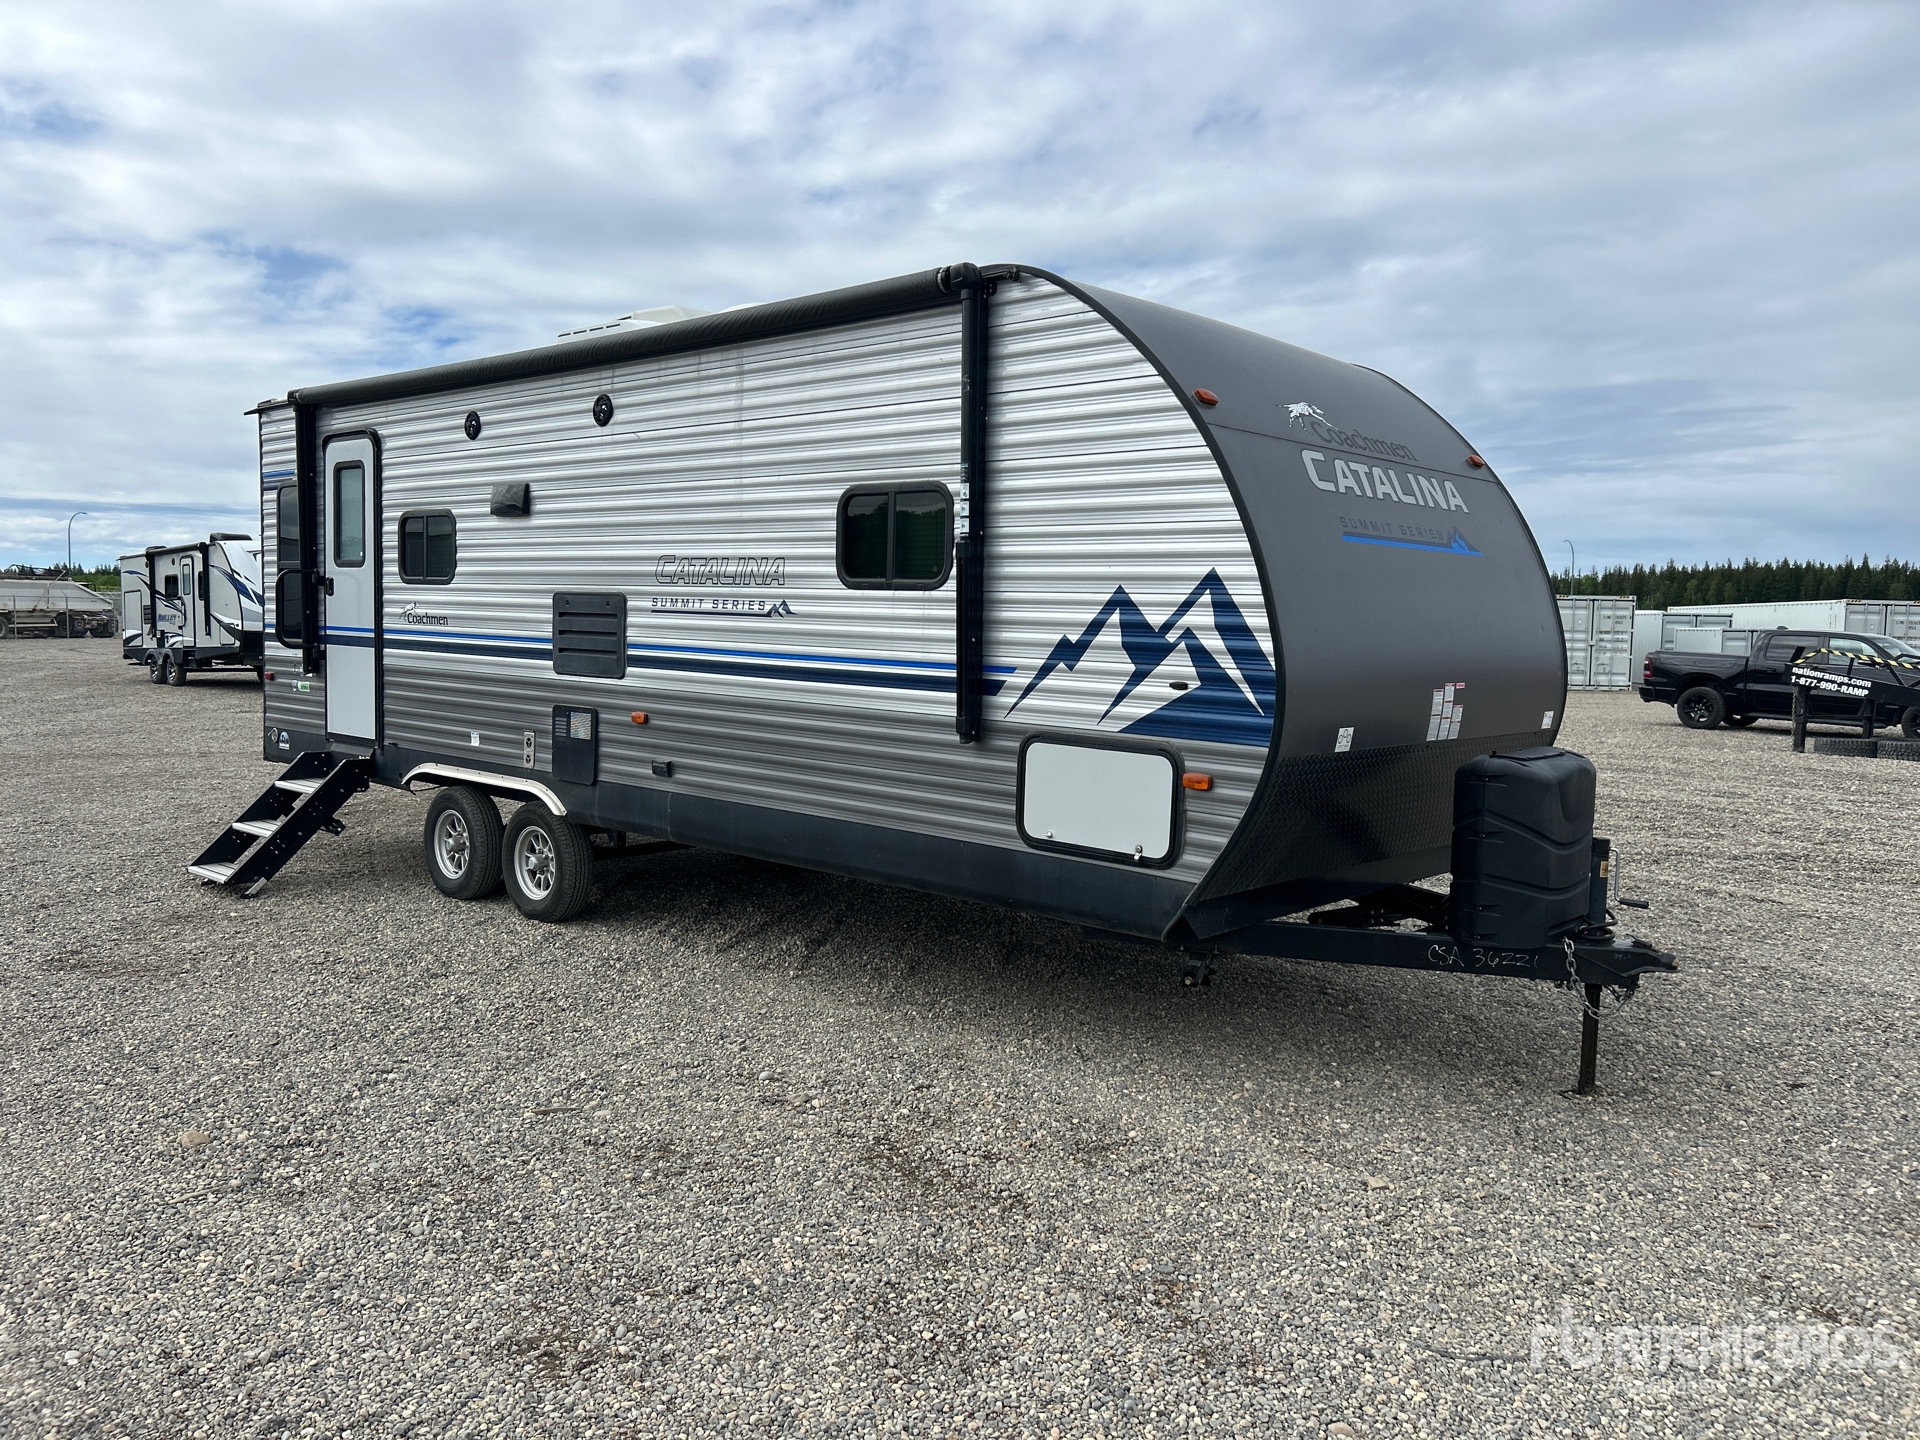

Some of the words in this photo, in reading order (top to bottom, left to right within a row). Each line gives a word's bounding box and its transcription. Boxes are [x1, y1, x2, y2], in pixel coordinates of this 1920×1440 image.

[1310, 420, 1419, 462] Coachmen
[1301, 449, 1470, 514] CATALINA
[1339, 515, 1394, 534] SUMMIT
[1398, 523, 1446, 541] SERIES
[655, 555, 786, 586] CATALINA
[651, 597, 705, 609] SUMMIT
[711, 599, 767, 611] SERIES
[406, 611, 449, 626] Coachmen
[1790, 675, 1869, 697] 1-877-990-RAMP
[1791, 666, 1872, 688] nationramps.com
